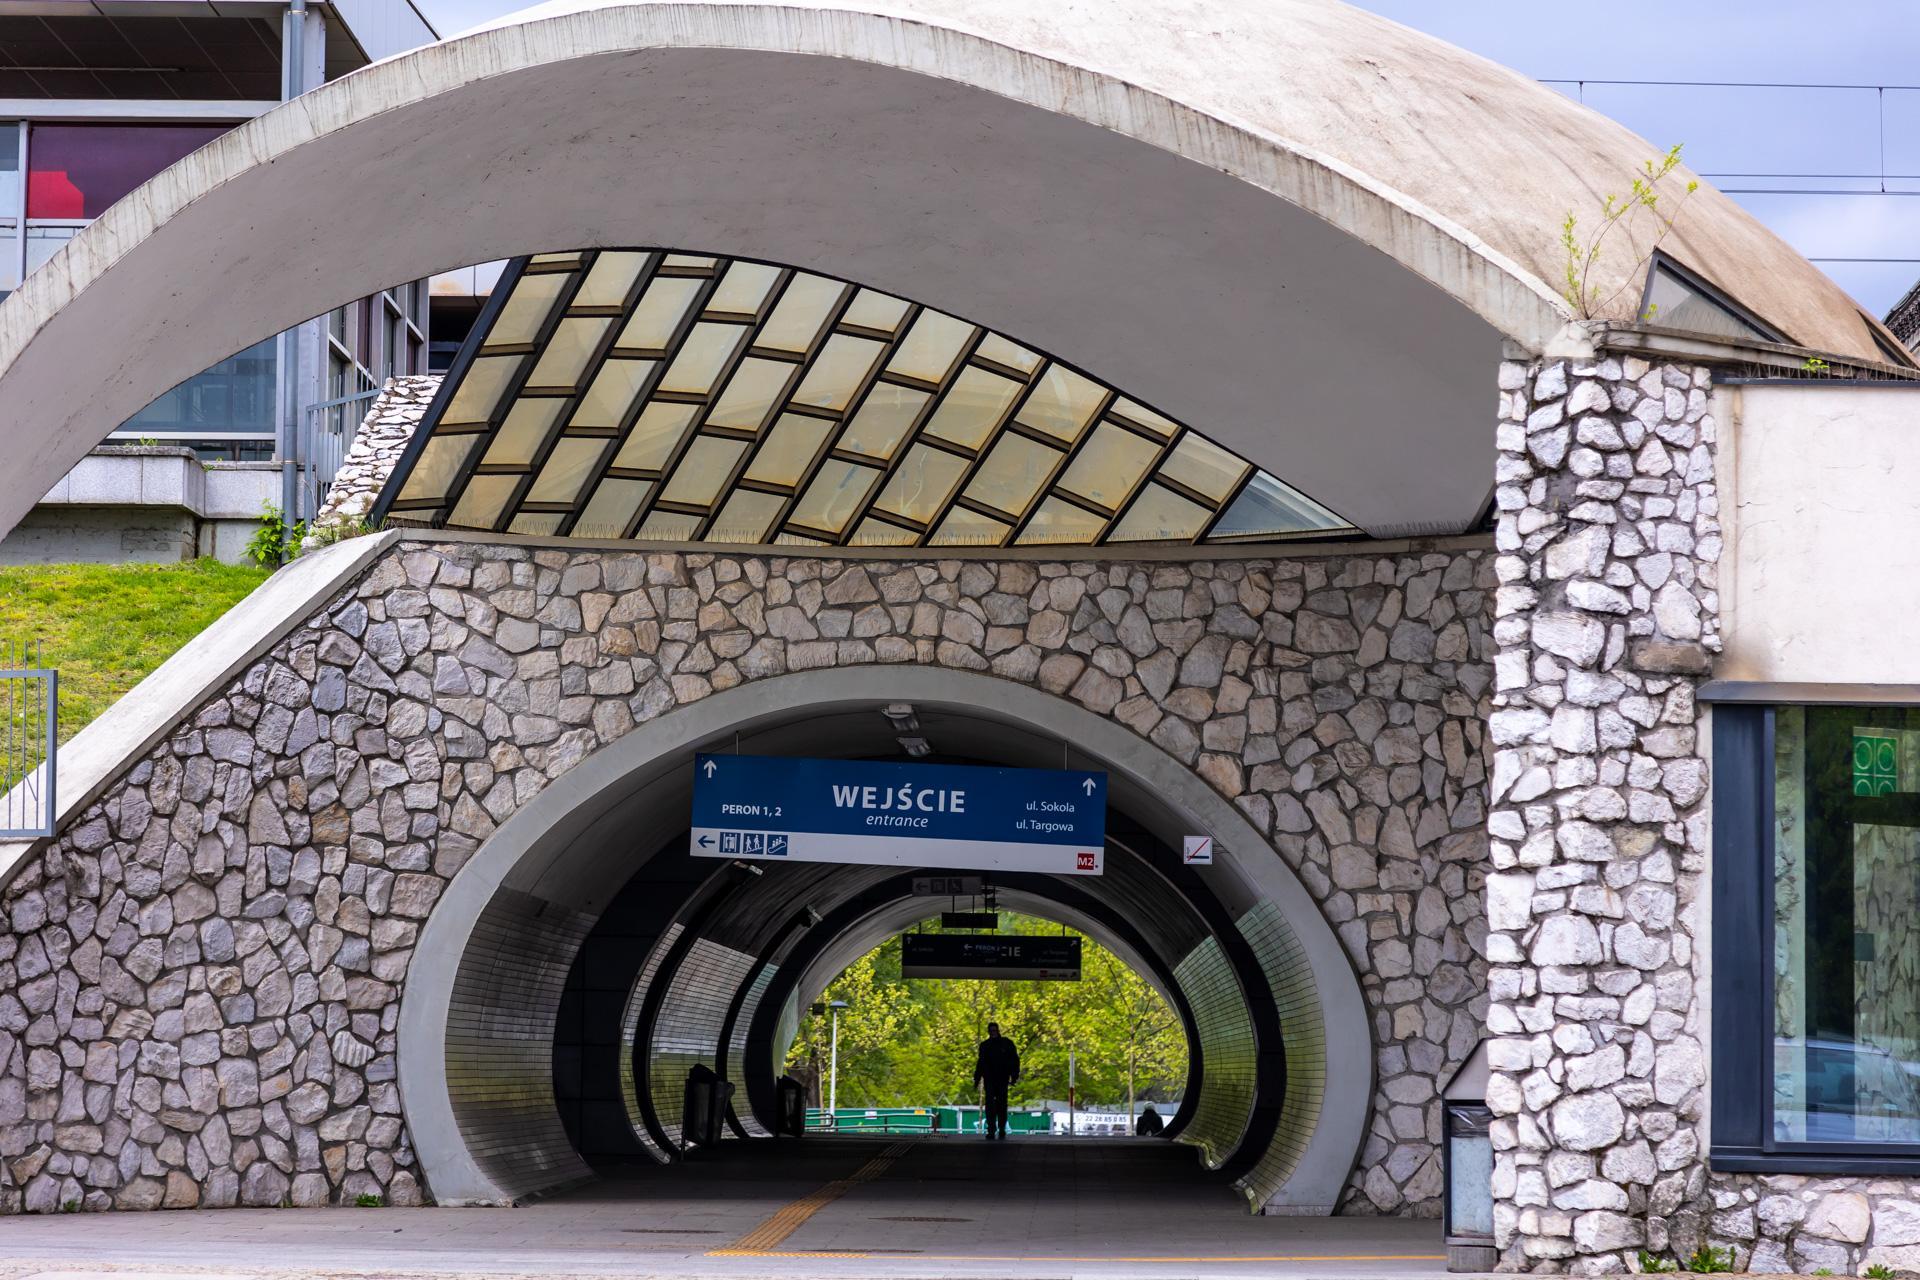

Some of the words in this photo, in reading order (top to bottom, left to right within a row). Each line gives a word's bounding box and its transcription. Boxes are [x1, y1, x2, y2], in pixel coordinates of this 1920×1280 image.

[832, 783, 966, 813] WEJŚCIE
[721, 804, 760, 816] PERON
[762, 806, 772, 818] 1,
[774, 807, 782, 817] 2
[1026, 801, 1038, 811] ul.
[1040, 801, 1075, 813] Sokola
[866, 814, 929, 828] entrance
[1016, 819, 1028, 830] ul.
[1030, 819, 1074, 833] Targowa
